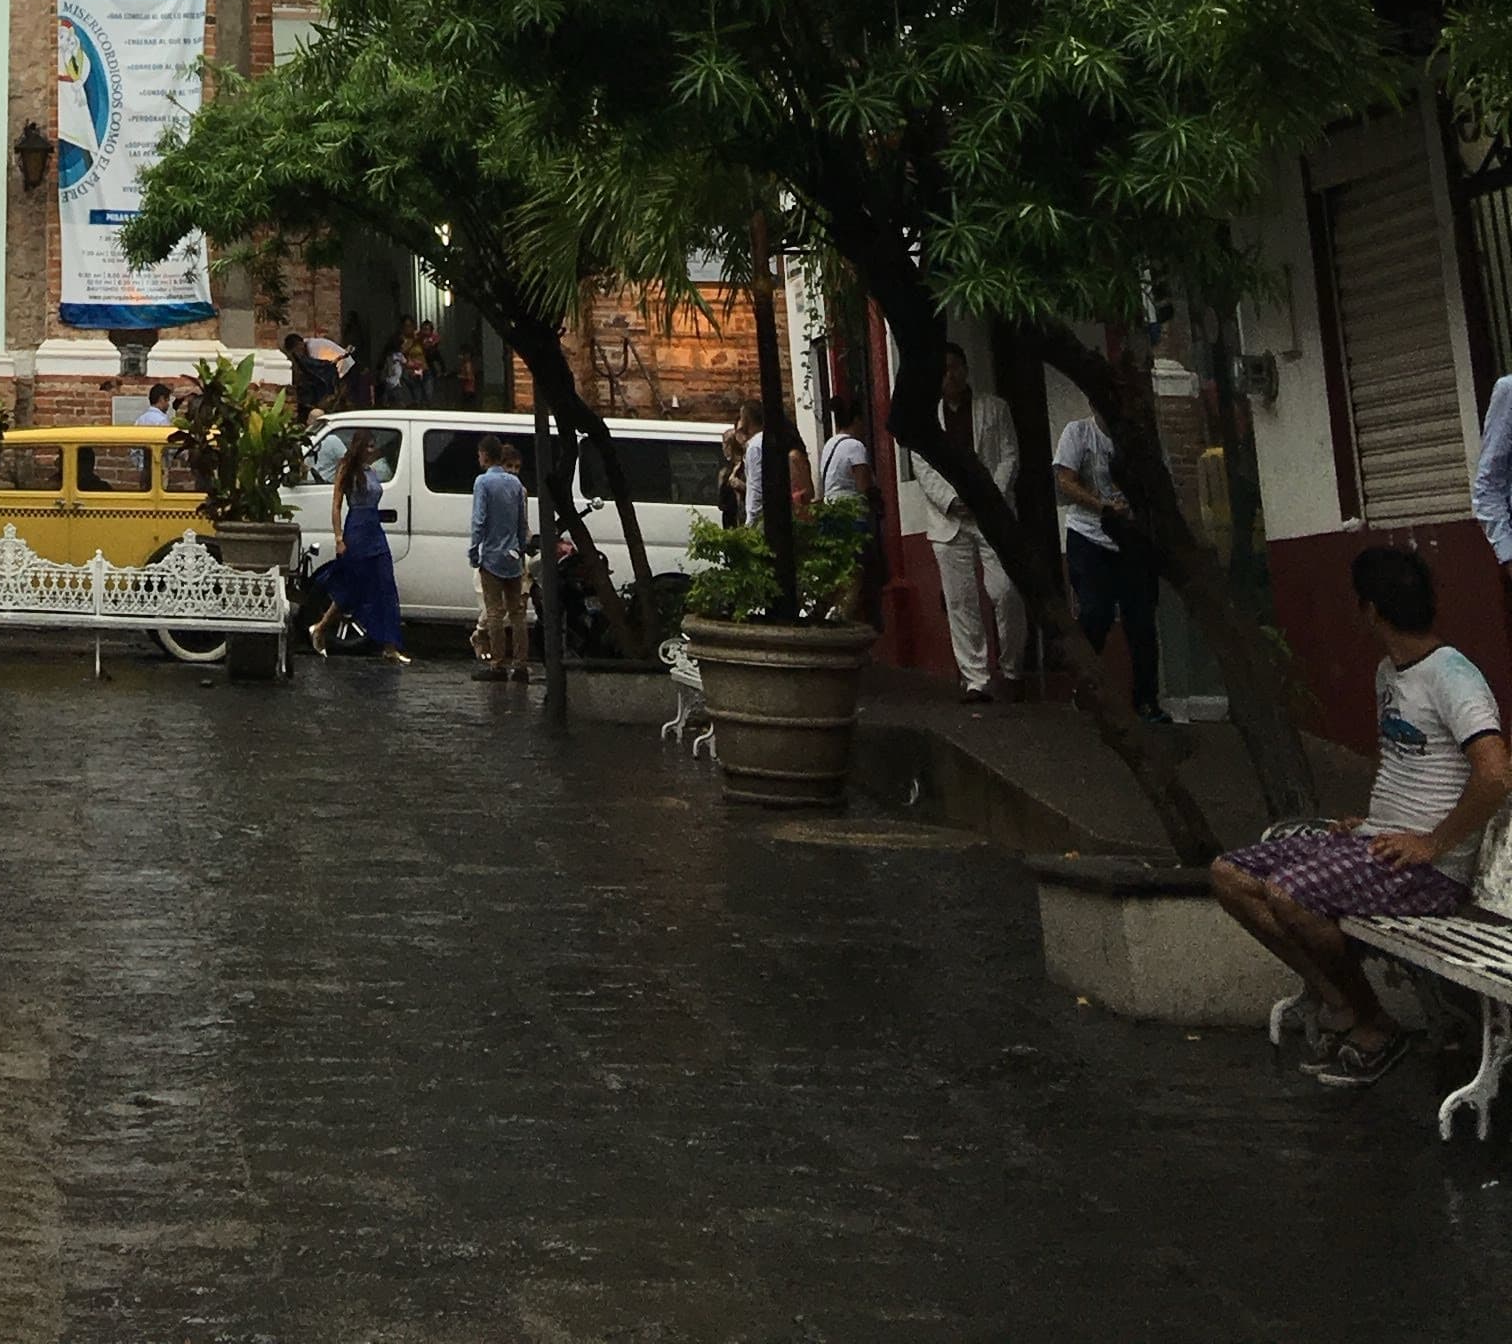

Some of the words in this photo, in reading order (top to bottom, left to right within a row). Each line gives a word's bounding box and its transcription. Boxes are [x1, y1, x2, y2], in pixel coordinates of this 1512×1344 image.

[104, 111, 123, 155] COMO
[95, 155, 111, 172] EL
[61, 172, 101, 204] PADRE
